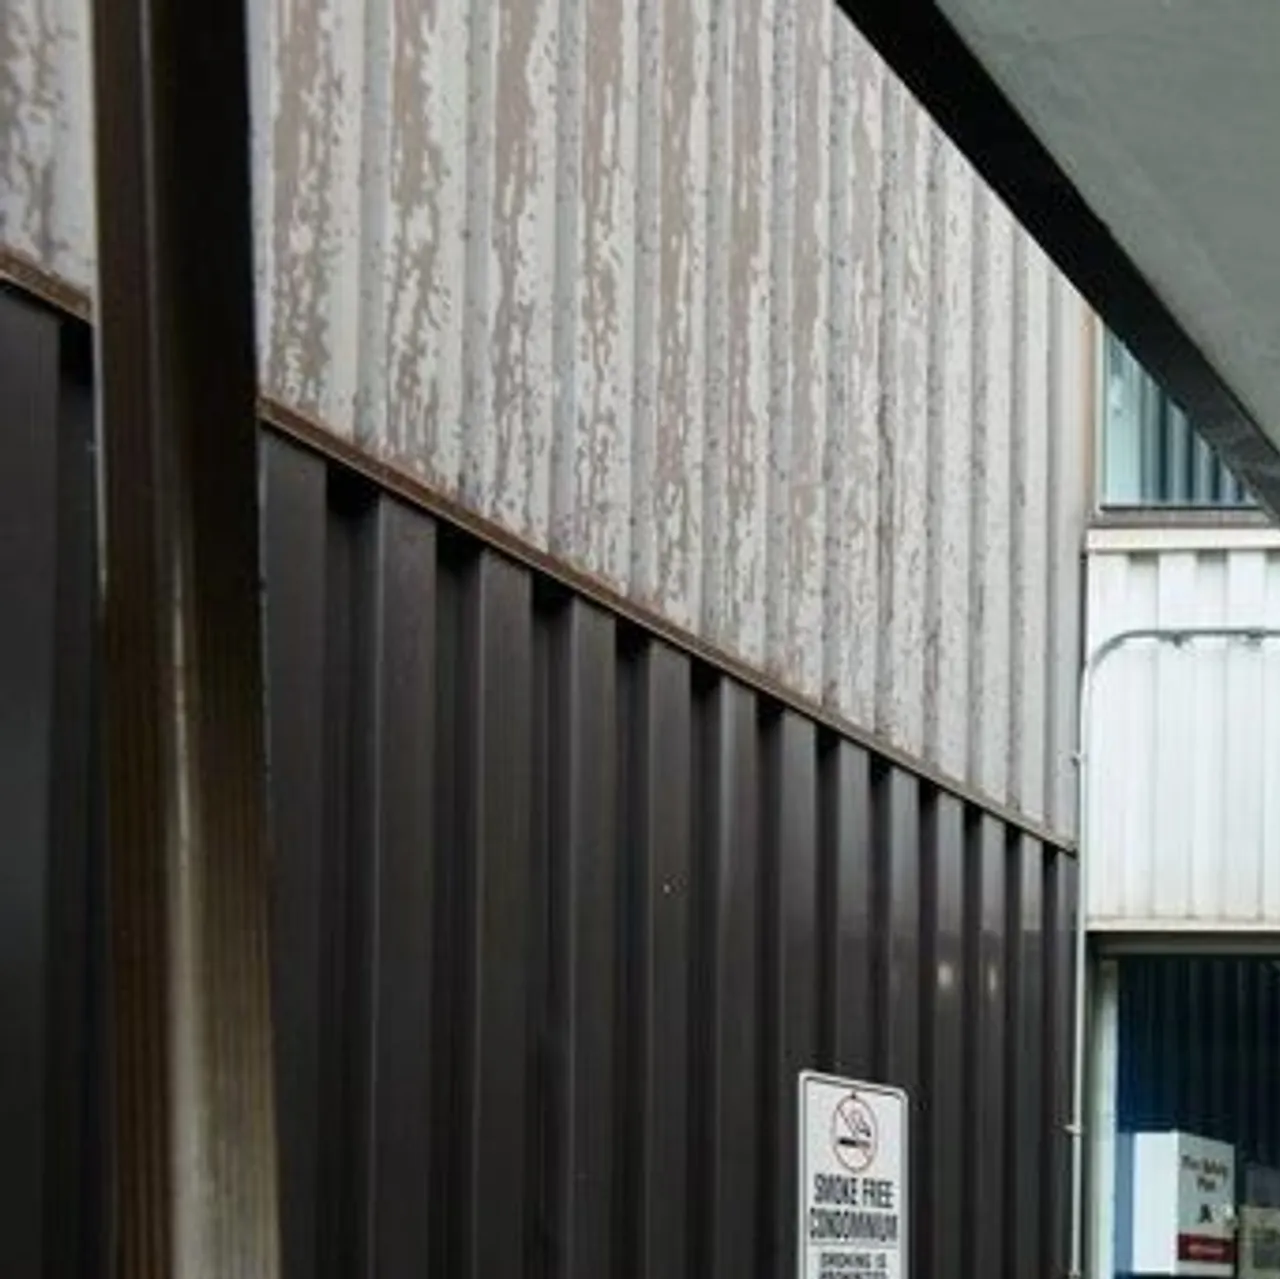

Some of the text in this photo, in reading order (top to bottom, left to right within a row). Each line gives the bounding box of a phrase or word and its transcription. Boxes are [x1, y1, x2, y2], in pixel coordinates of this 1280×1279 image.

[814, 1173, 894, 1209] SMOKE FREE
[810, 1207, 897, 1242] CONDOMINIUM
[820, 1252, 886, 1269] SMOKING IS
